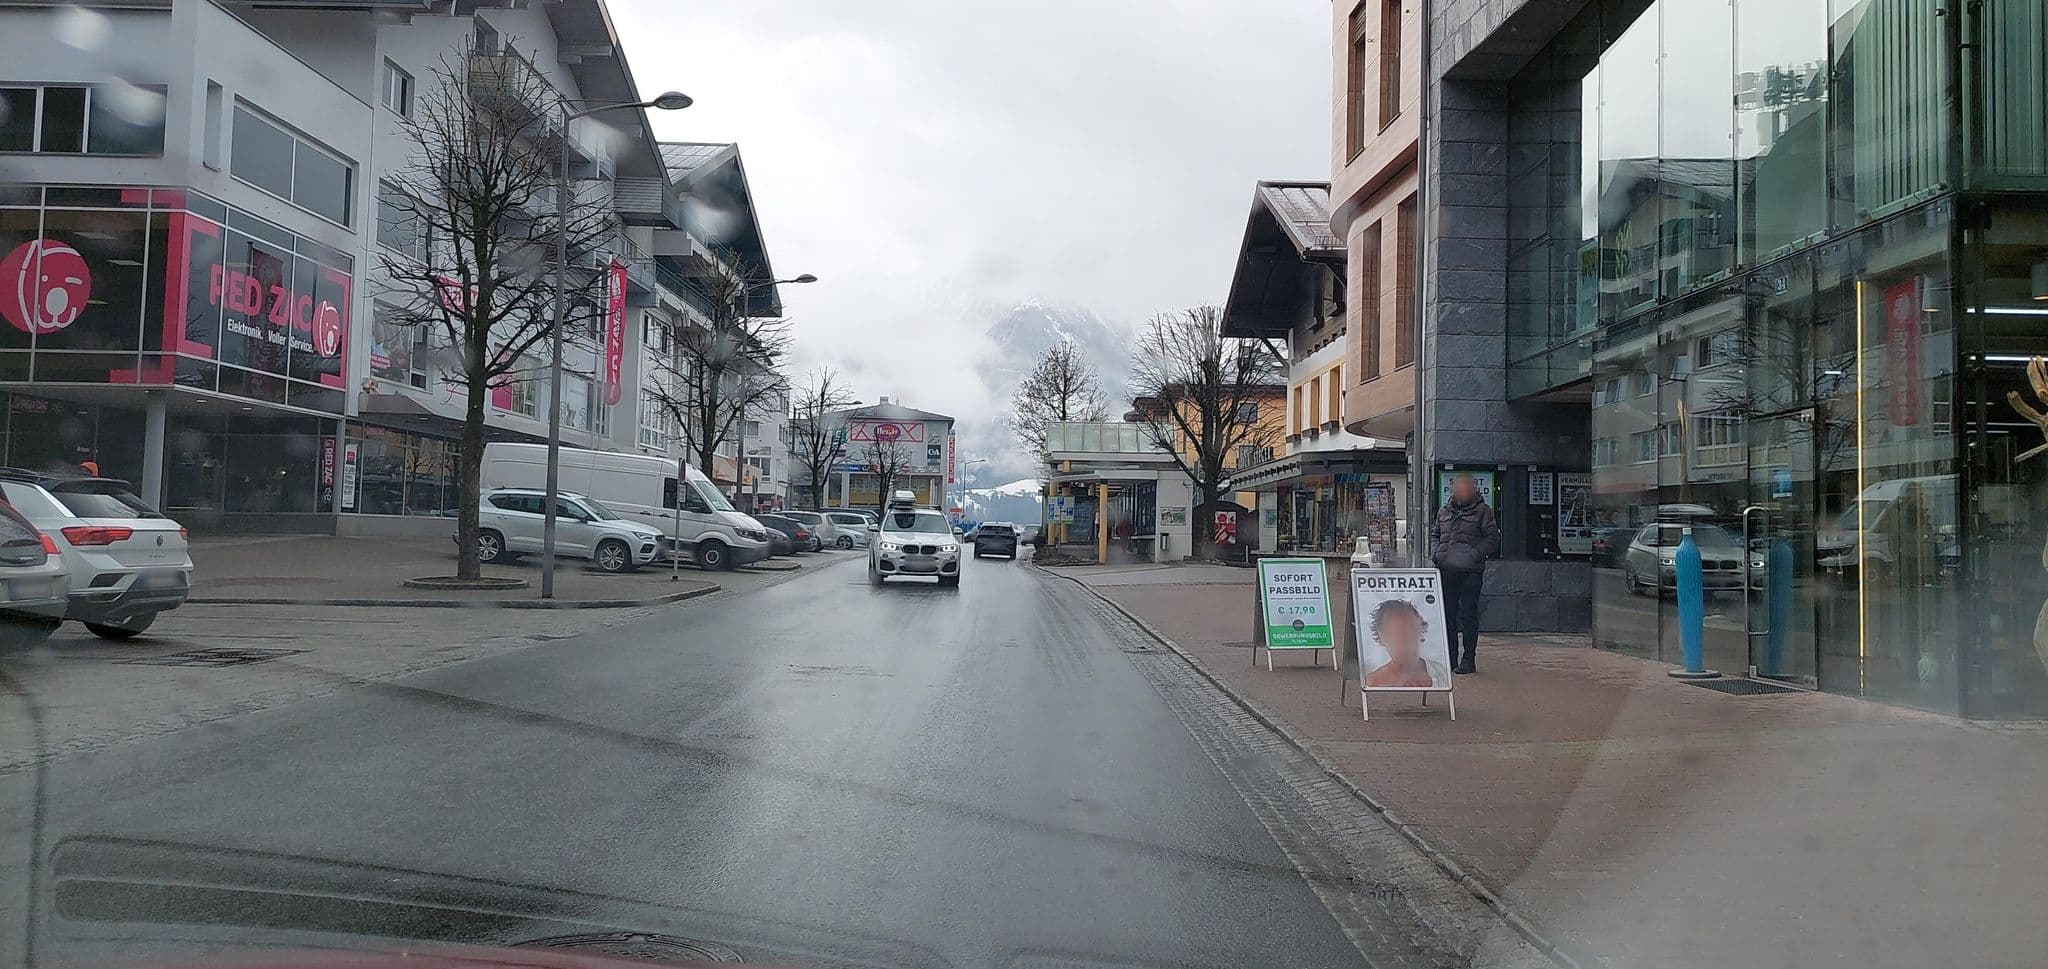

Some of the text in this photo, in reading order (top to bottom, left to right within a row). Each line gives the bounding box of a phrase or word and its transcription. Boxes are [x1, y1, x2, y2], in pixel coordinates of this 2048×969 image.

[1776, 277, 1787, 291] 34
[209, 263, 313, 333] RED ZAC
[227, 318, 314, 354] Elektronik. Voller Service.
[325, 447, 333, 465] RED
[324, 465, 333, 486] ZAC
[1273, 574, 1313, 583] SOFORT
[1357, 577, 1435, 589] PORTRAIT
[1269, 586, 1321, 595] PASSBILD
[1277, 606, 1316, 616] € 17,90
